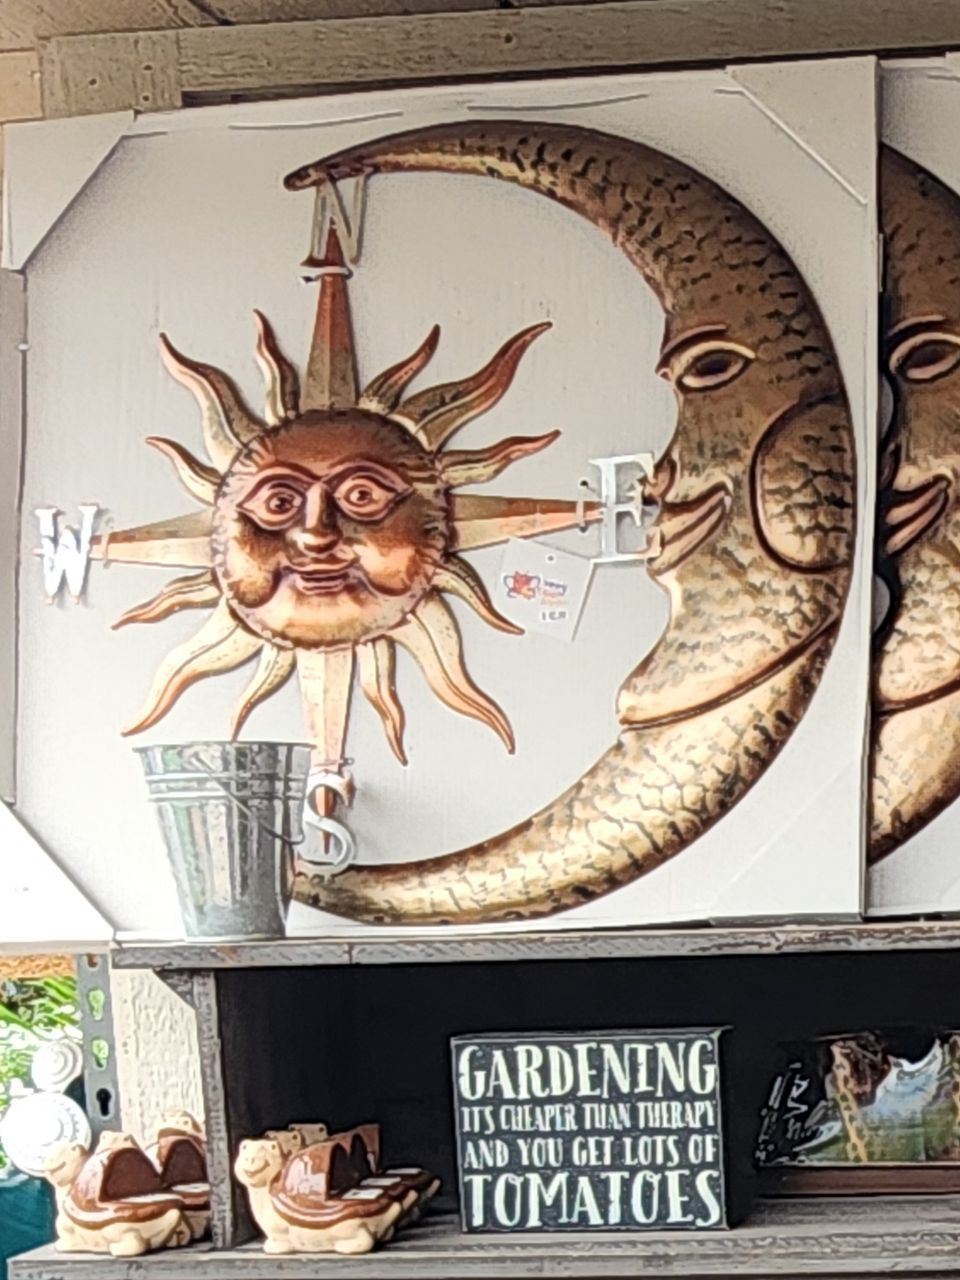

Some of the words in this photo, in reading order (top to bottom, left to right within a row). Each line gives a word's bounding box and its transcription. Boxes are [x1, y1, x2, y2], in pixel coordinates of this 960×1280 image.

[588, 452, 662, 563] E
[34, 505, 97, 604] W
[458, 1040, 717, 1100] GARDENING
[500, 1104, 578, 1131] CHEAPER
[582, 1103, 631, 1130] THAN
[636, 1100, 716, 1129] THERAPY
[464, 1139, 509, 1169] AND
[517, 1138, 563, 1167] YOU
[572, 1136, 613, 1165] GET
[622, 1135, 679, 1165] LOTS
[688, 1134, 719, 1163] OF
[463, 1169, 721, 1227] TOMATOES
